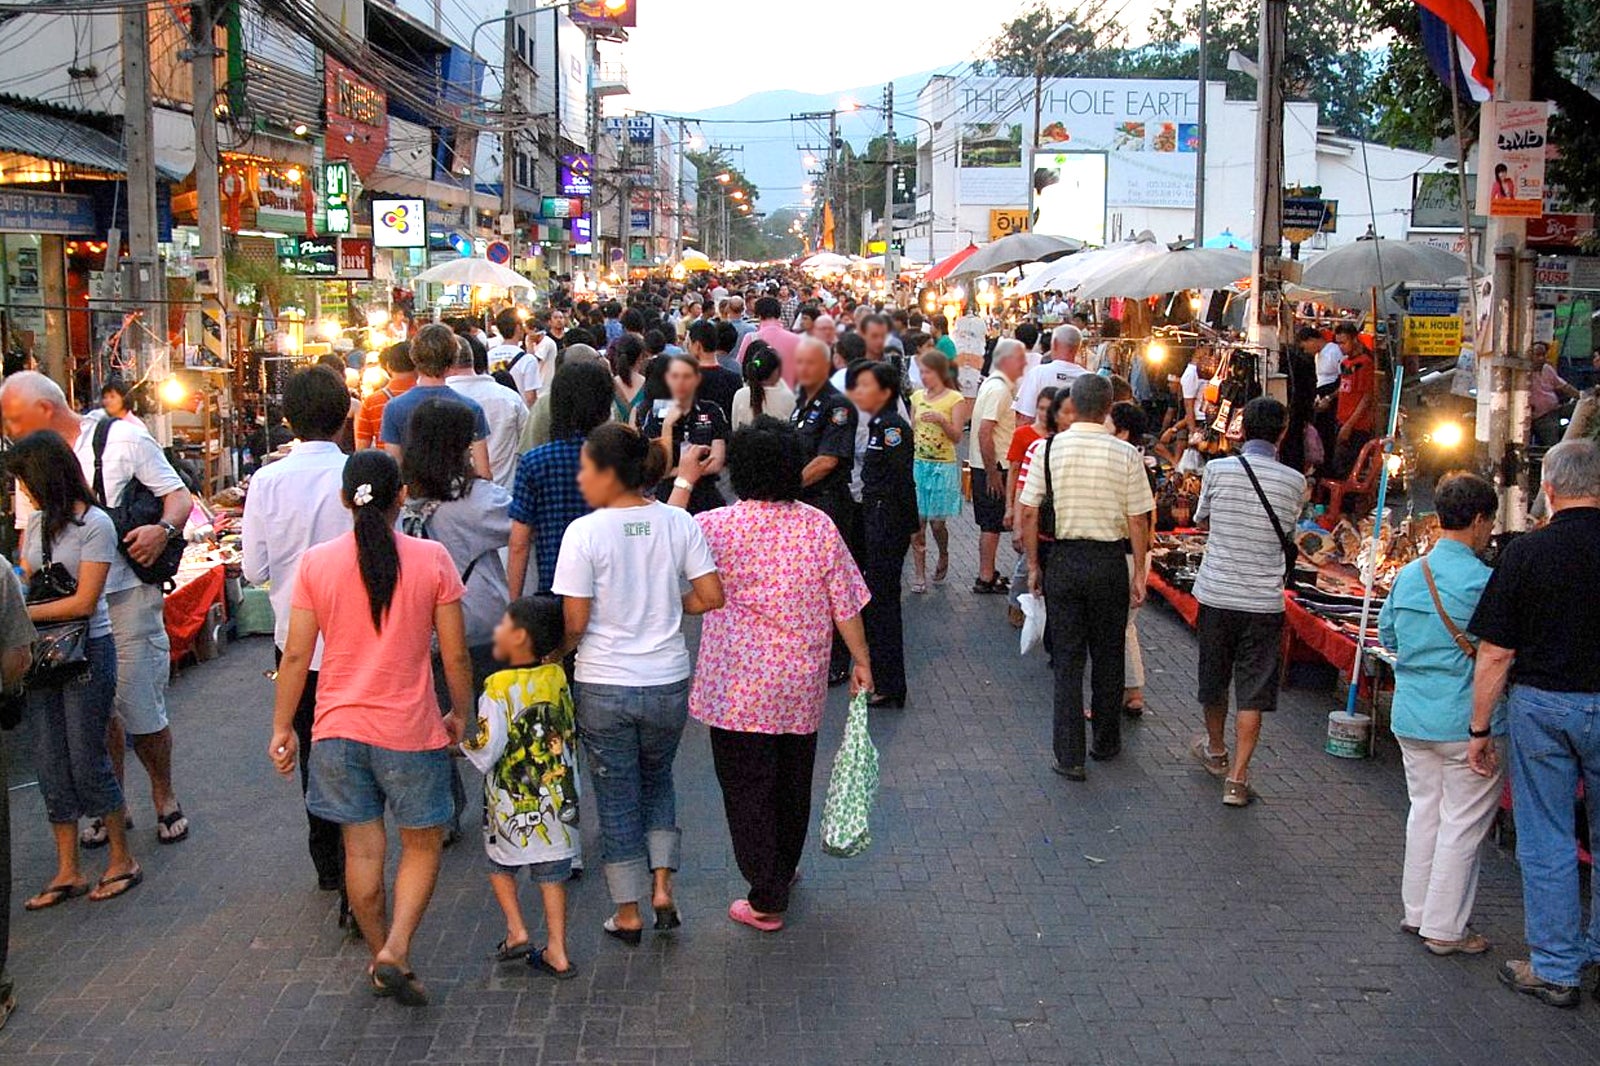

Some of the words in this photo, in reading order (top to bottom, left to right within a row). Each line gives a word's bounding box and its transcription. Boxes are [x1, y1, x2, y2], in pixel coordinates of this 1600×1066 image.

[960, 87, 1007, 114] THE
[1017, 89, 1115, 116] WHOLE
[1126, 90, 1200, 117] EARTH
[1430, 320, 1460, 330] HOUSE
